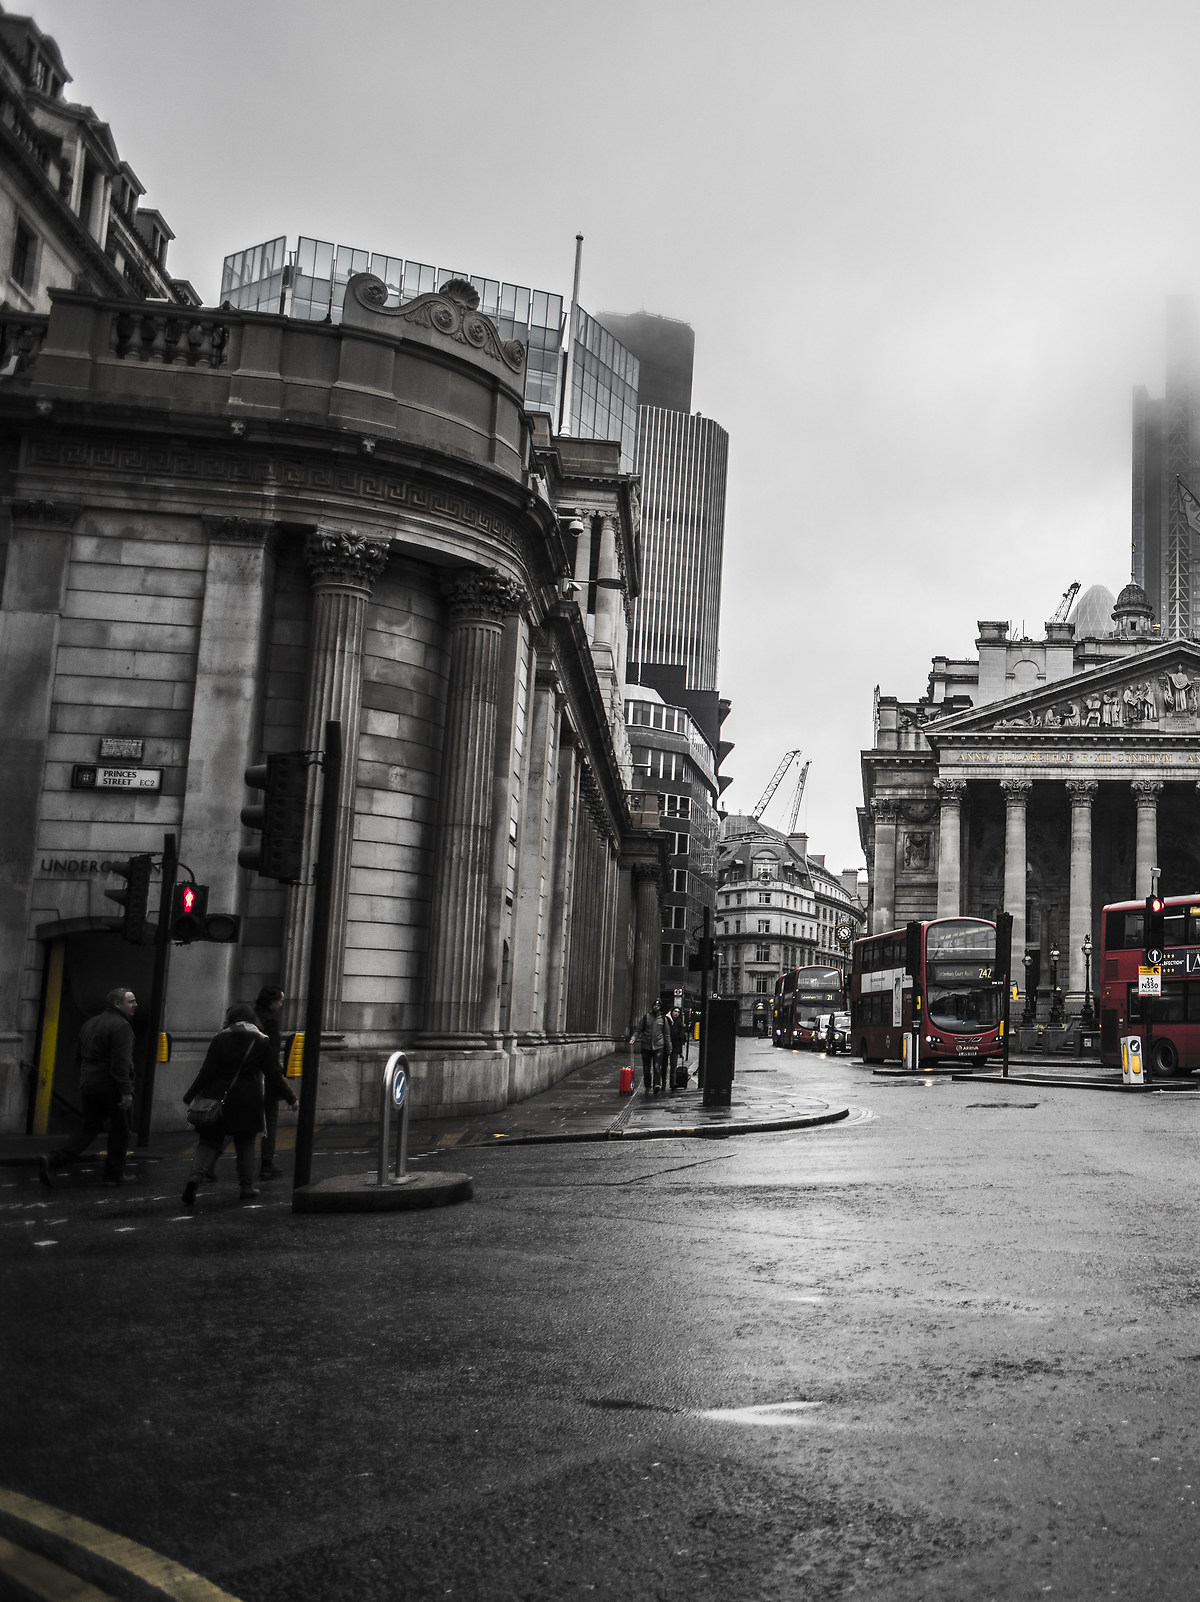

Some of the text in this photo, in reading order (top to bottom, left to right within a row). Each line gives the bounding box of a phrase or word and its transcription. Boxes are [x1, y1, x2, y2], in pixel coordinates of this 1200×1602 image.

[957, 753, 990, 762] ANNO
[996, 753, 1075, 763] ELIZABETHAE
[103, 770, 137, 778] PRINCES
[103, 778, 132, 786] STREET
[978, 968, 992, 979] 242
